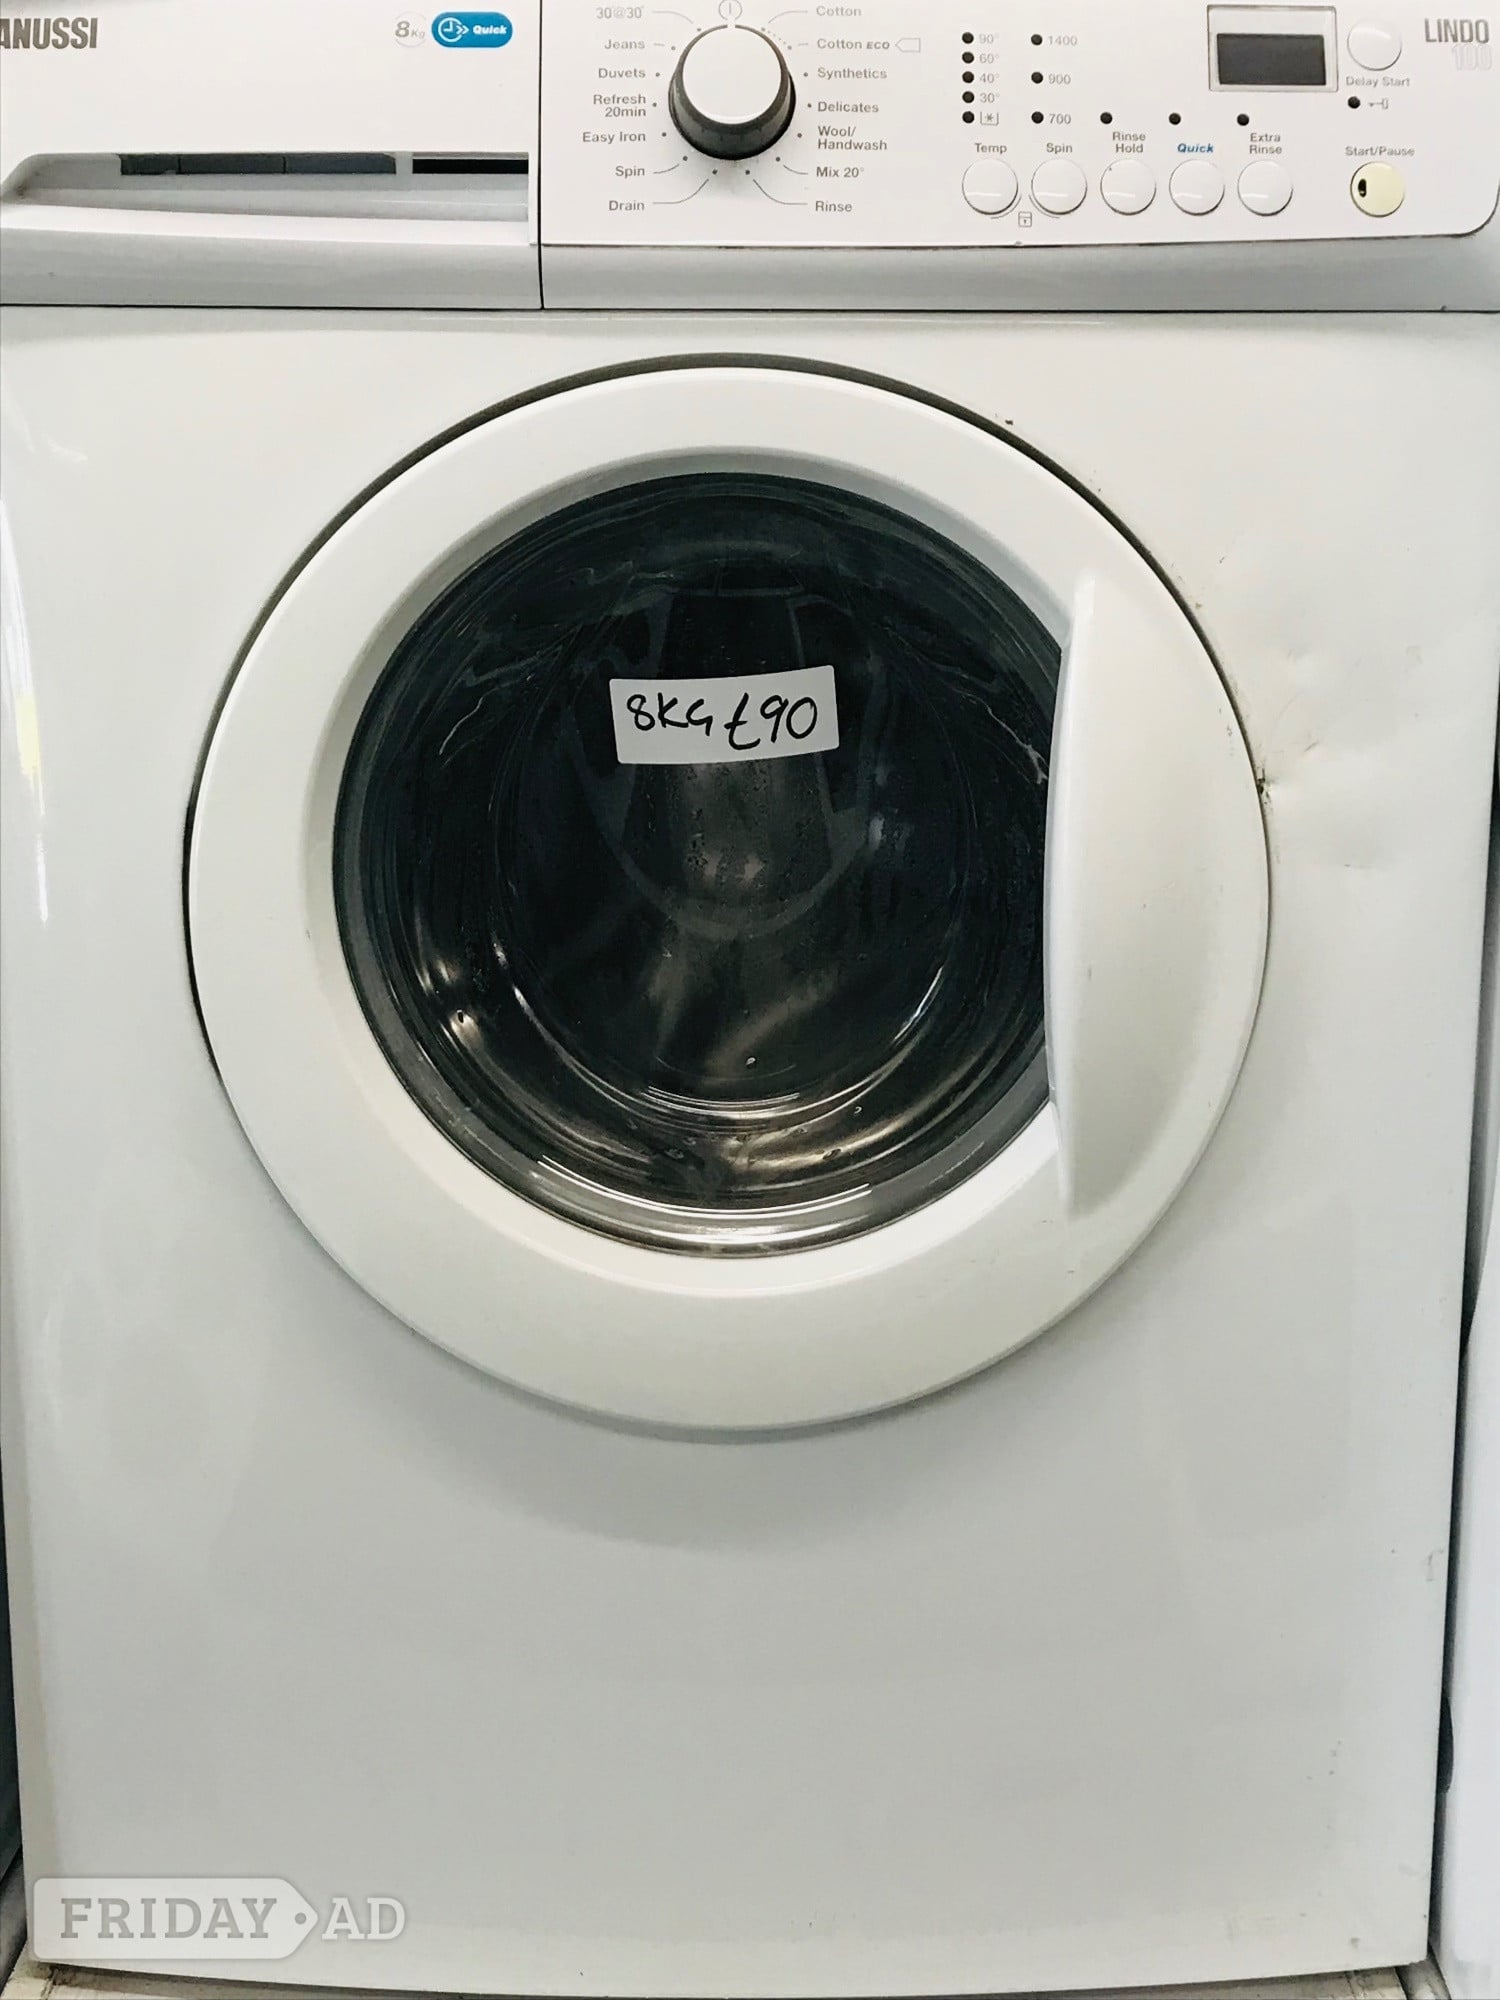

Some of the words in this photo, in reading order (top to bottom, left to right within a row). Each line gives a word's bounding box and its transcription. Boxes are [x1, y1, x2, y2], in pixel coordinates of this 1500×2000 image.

[816, 5, 862, 18] Cotton
[472, 24, 507, 35] Quick
[1424, 18, 1489, 44] LINDO
[604, 39, 646, 51] Jeans
[816, 38, 863, 51] Cotton
[1048, 35, 1078, 46] 1400
[598, 67, 646, 80] Duvets
[817, 67, 888, 81] Synthetics
[1048, 73, 1072, 85] 900
[1345, 76, 1379, 88] Delay
[1382, 76, 1410, 87] Start
[593, 93, 647, 106] Refresh
[604, 106, 647, 118] 20min
[817, 101, 880, 114] Delicates
[1048, 113, 1072, 125] 700
[582, 131, 614, 146] Easy
[619, 130, 647, 143] Iron
[817, 125, 857, 138] Wool/
[1112, 130, 1147, 143] Rinse
[1249, 131, 1282, 144] Extra
[817, 138, 888, 151] Handwash
[974, 142, 1008, 155] Temp
[1045, 142, 1074, 155] Spin
[1115, 142, 1145, 154] Hold
[1176, 142, 1215, 155] Quick
[1248, 143, 1284, 155] Rinse
[1344, 144, 1416, 157] Start/Pause
[614, 164, 646, 179] Spin
[815, 165, 840, 179] Mix
[607, 198, 646, 213] Drain
[814, 199, 854, 213] Rinse
[625, 691, 714, 737] 8KG
[723, 692, 819, 751] £90
